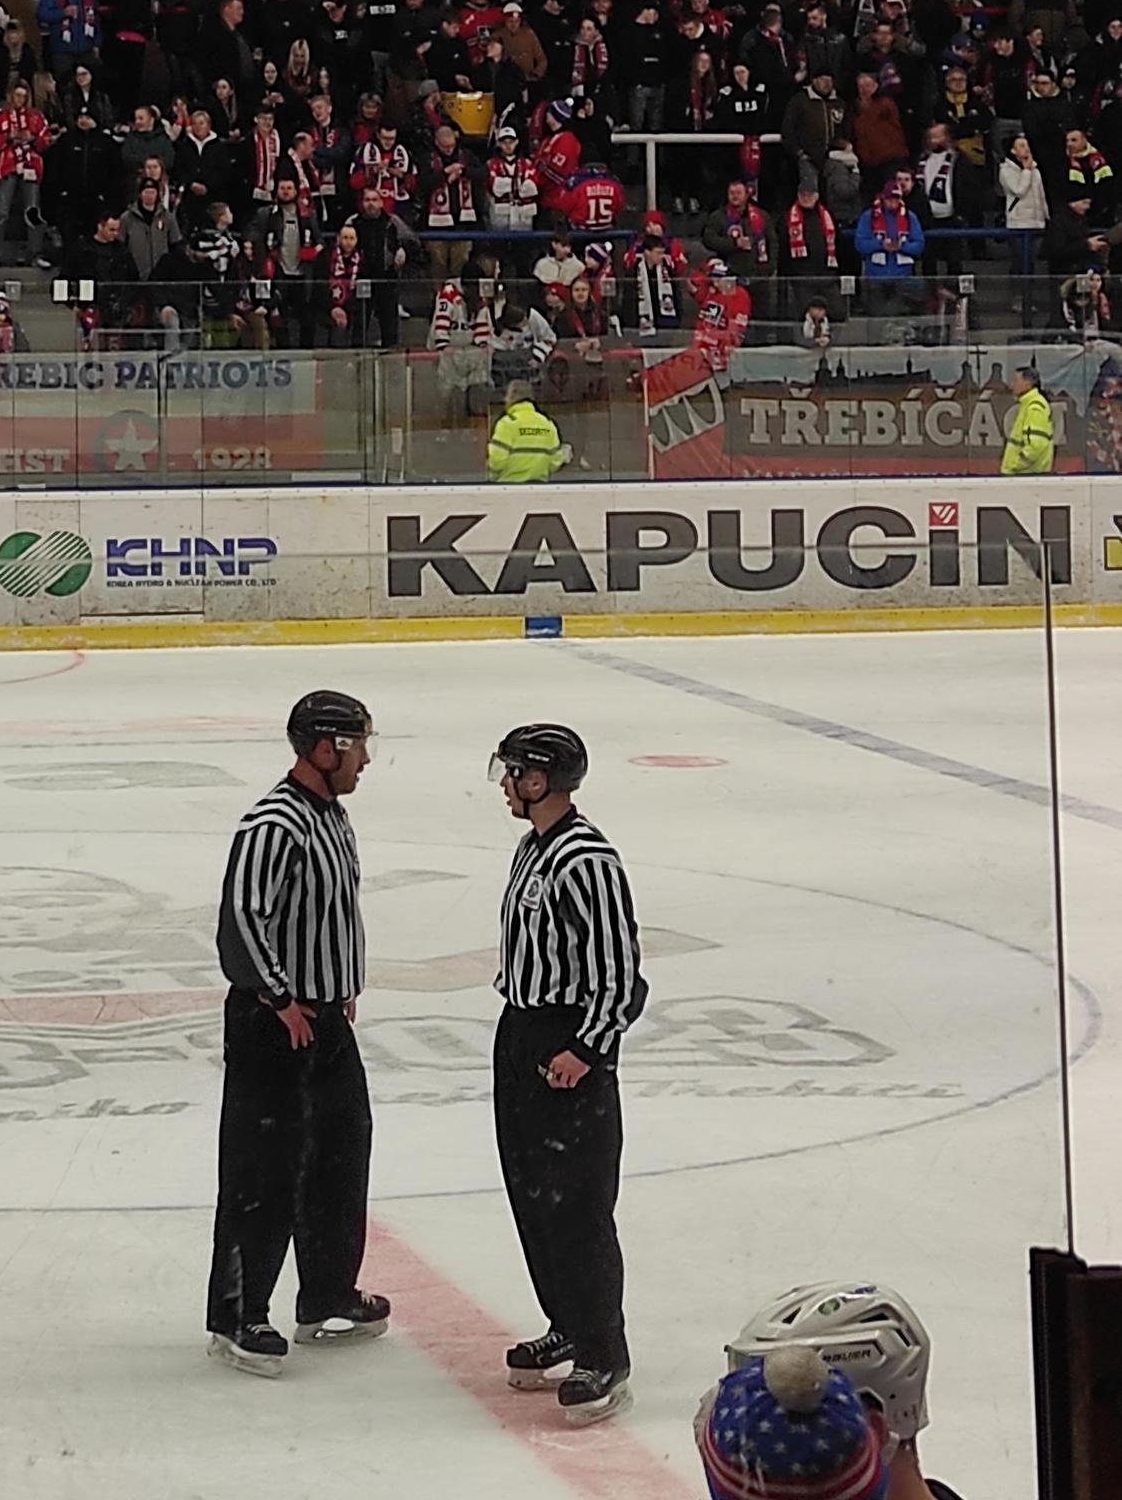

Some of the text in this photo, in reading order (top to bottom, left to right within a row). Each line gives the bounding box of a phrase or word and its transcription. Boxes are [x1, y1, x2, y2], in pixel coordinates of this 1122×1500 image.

[586, 198, 613, 224] 15
[114, 359, 293, 390] PATRIOTS
[192, 447, 273, 471] 1928
[106, 538, 278, 577] KHNP
[262, 578, 277, 587] LTD
